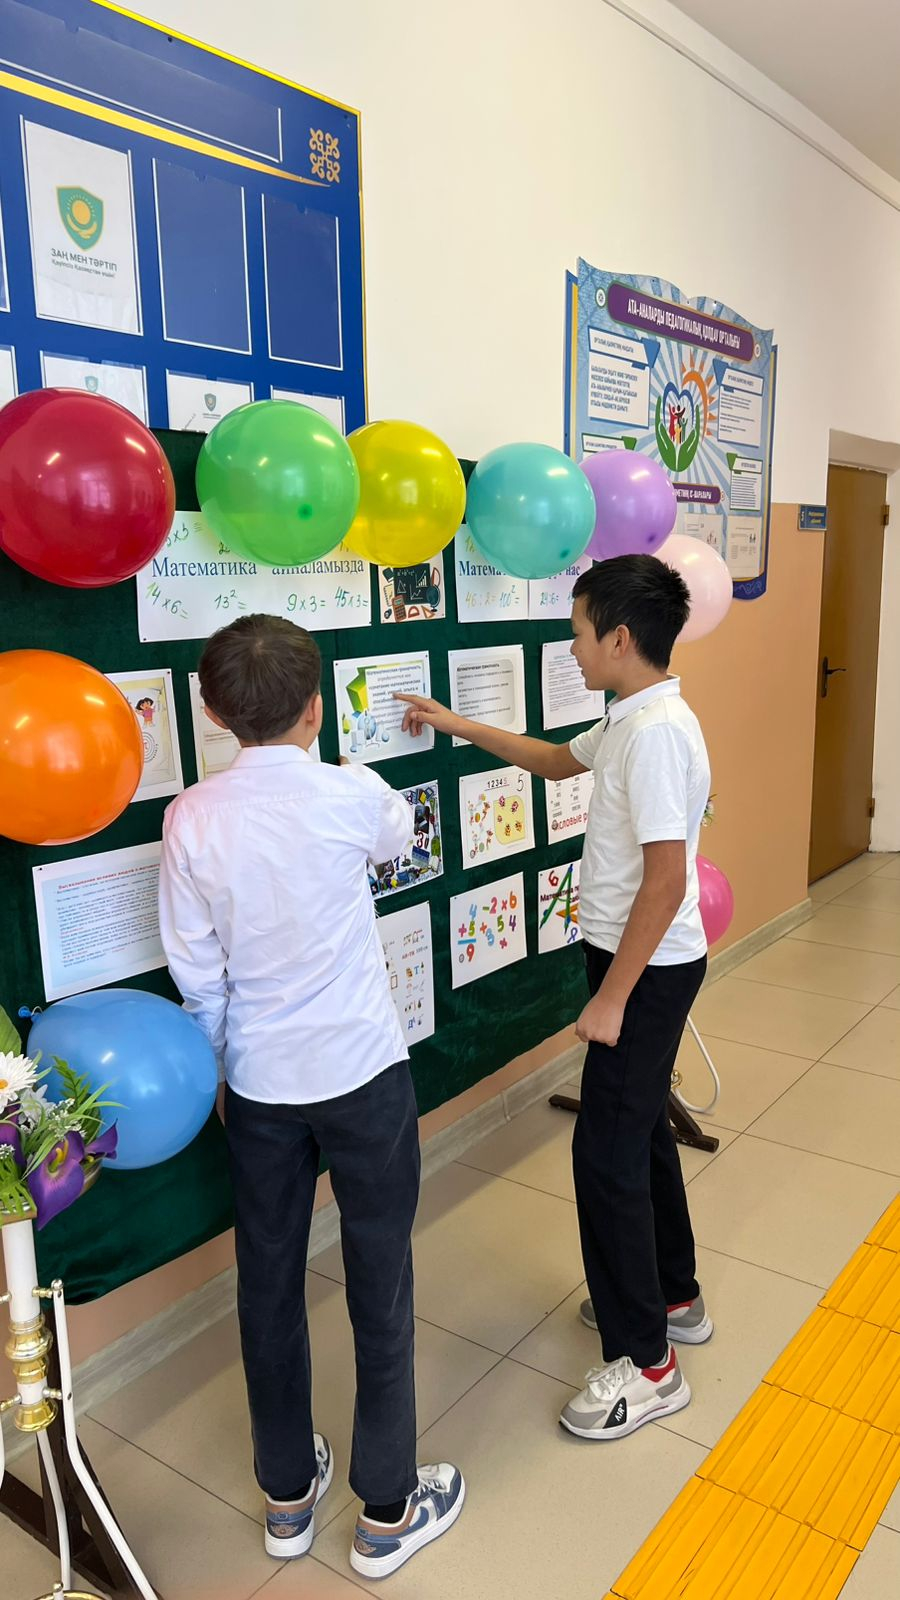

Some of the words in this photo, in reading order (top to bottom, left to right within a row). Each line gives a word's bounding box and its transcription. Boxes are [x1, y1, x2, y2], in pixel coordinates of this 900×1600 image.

[51, 248, 69, 261] ЗАҢ
[69, 253, 88, 265] МЕН
[89, 257, 117, 272] ТӘРТІП
[627, 298, 665, 326] АТА-АНАЛАРДЫ
[152, 557, 257, 577] Математика
[516, 773, 525, 792] 5
[548, 869, 558, 887] 6
